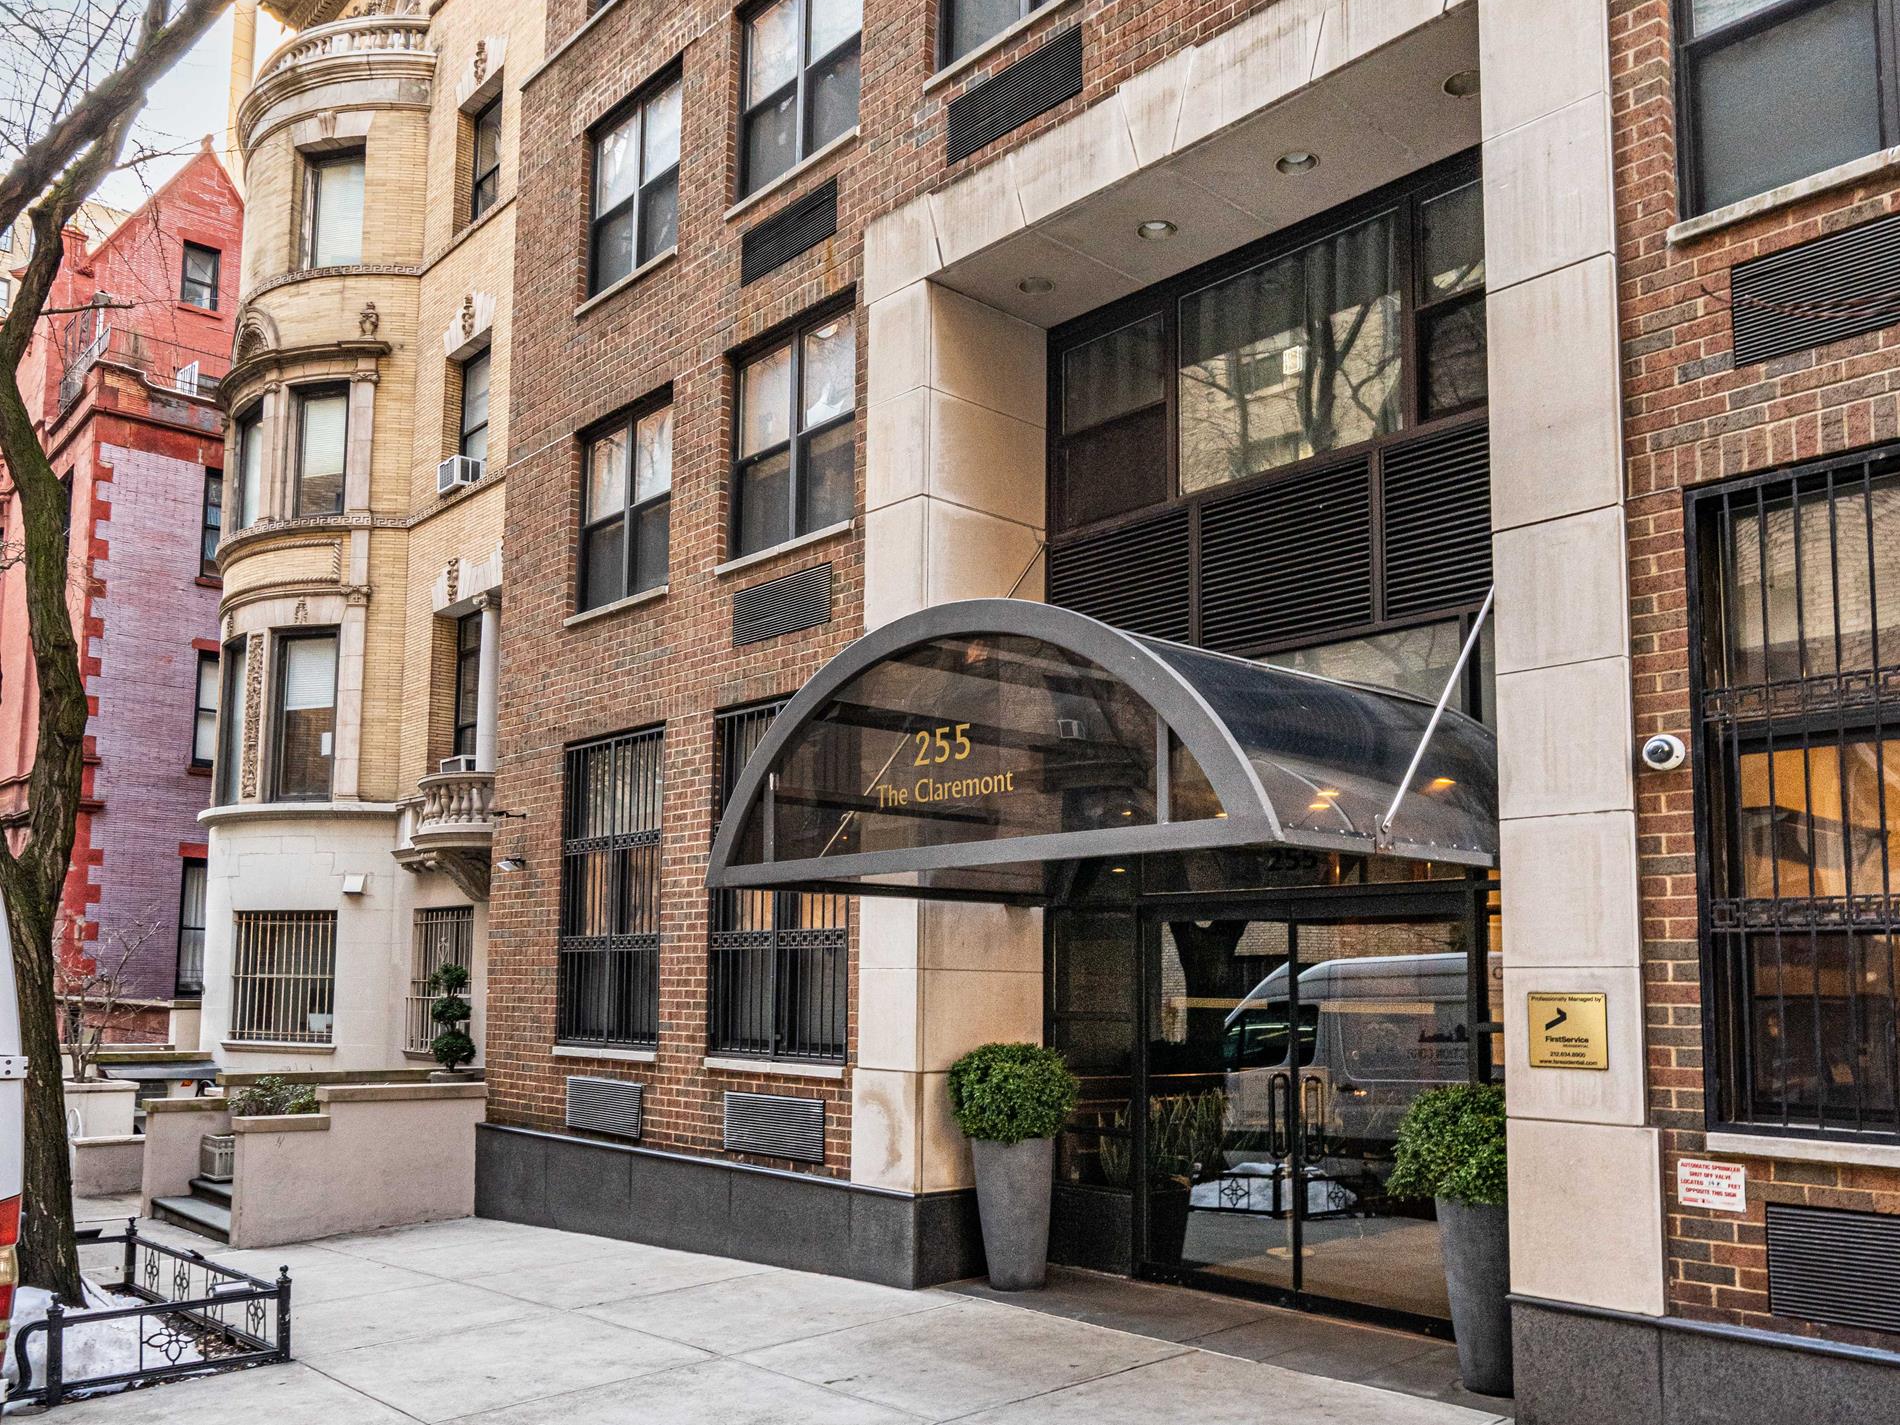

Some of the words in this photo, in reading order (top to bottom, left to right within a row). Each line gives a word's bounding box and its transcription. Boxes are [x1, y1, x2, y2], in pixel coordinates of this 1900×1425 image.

[914, 723, 971, 766] 255
[876, 784, 908, 808] The
[915, 770, 1014, 803] Claremont
[1267, 848, 1318, 871] 255
[1545, 1035, 1589, 1044] FirstService
[1680, 1162, 1711, 1170] AUTOMATIC
[1712, 1164, 1741, 1172] SPRINKLER
[1680, 1178, 1704, 1186] LOCATED
[1685, 1187, 1710, 1195] OPPOSITE
